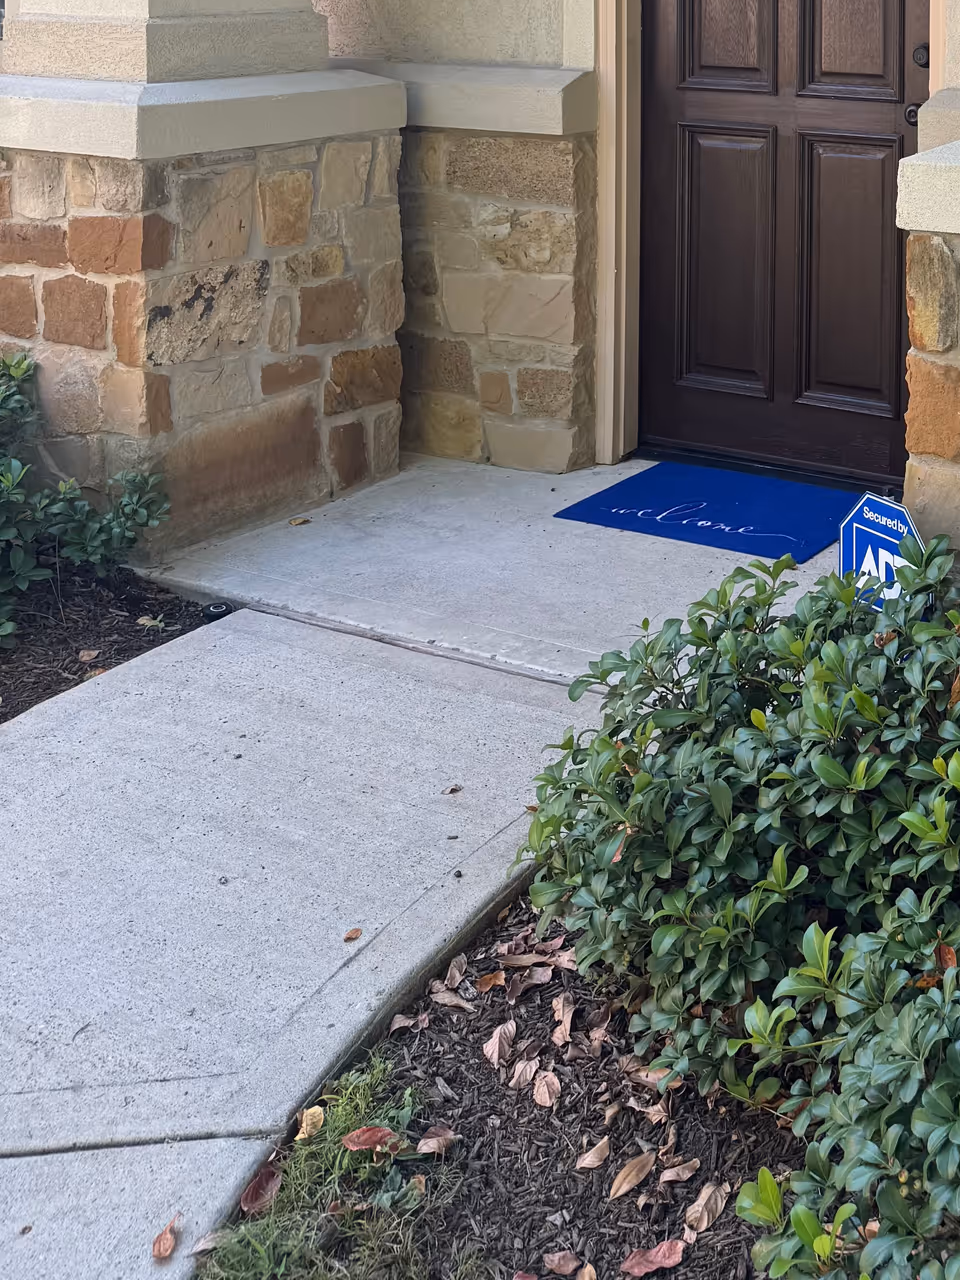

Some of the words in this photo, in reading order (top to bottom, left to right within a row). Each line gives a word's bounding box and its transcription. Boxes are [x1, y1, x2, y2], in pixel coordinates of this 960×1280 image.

[600, 502, 798, 541] welcome
[863, 506, 898, 530] Secured
[897, 519, 908, 536] by
